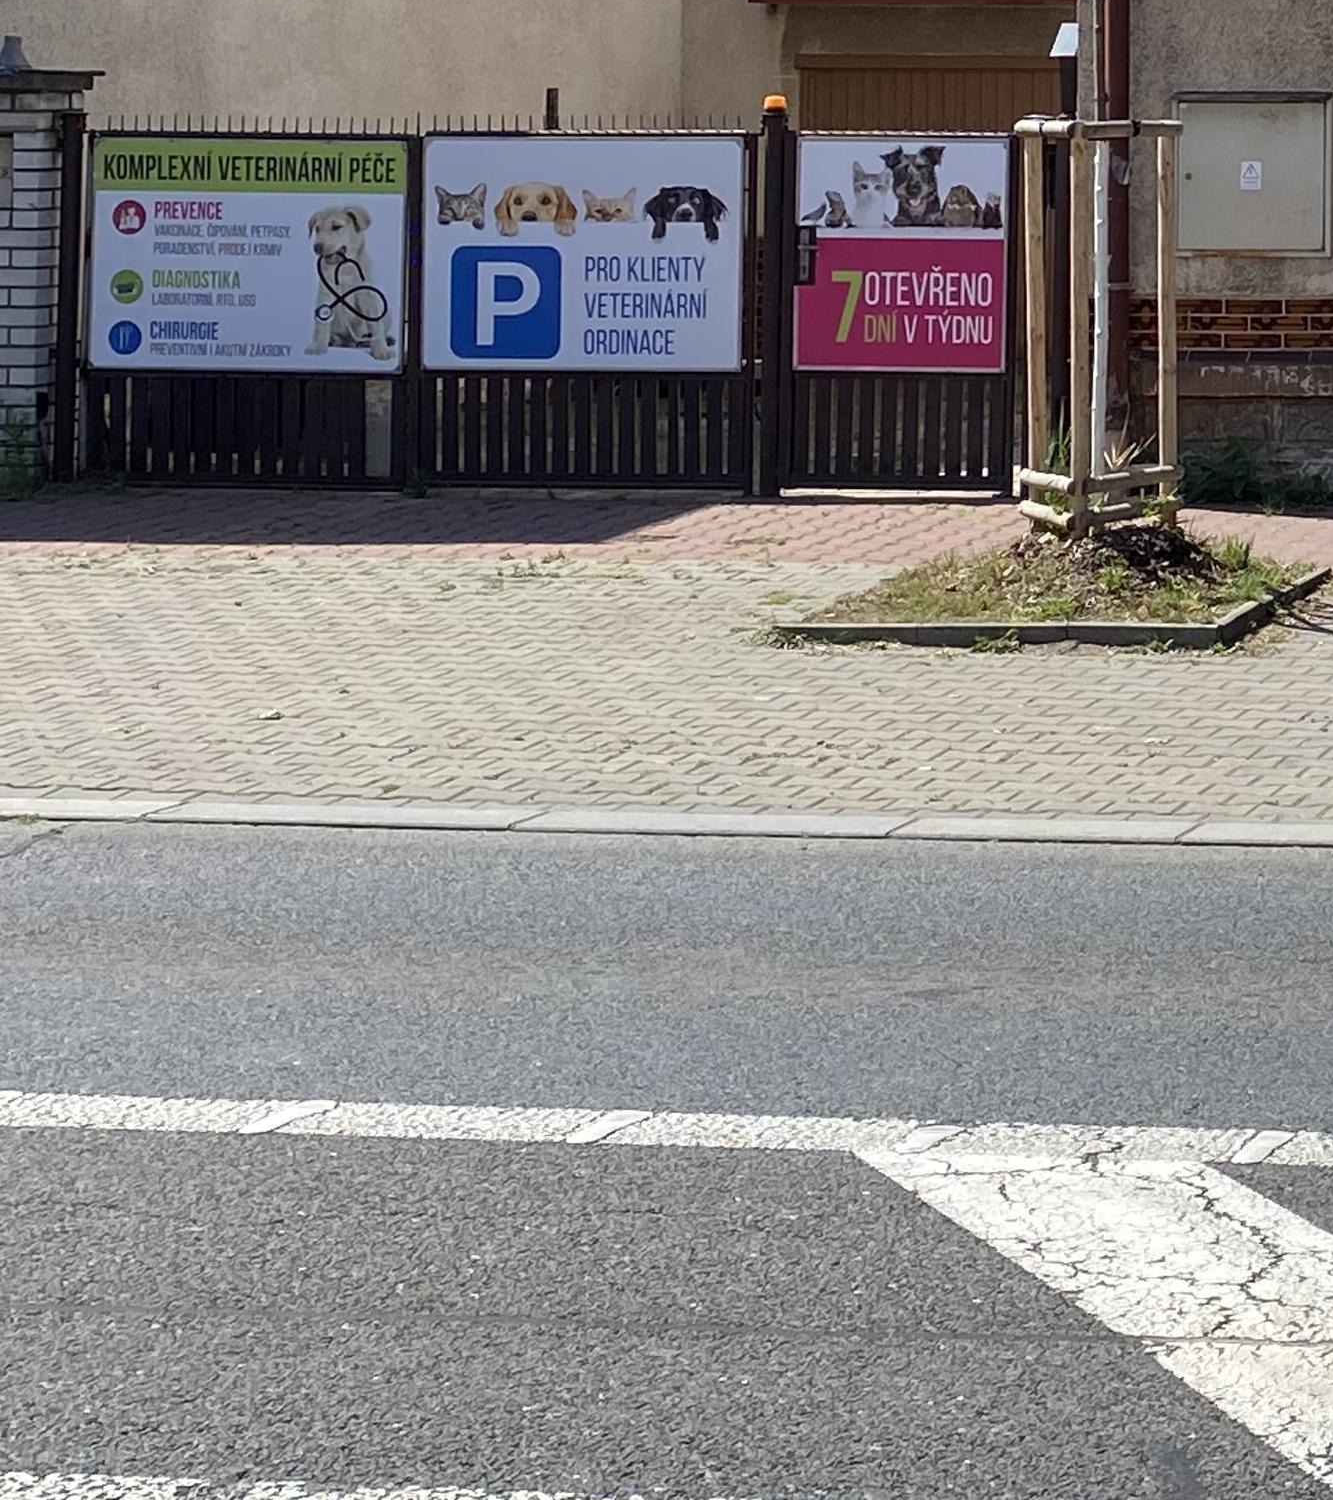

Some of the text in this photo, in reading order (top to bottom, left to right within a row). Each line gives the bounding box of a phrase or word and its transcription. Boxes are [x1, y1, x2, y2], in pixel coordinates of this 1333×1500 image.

[103, 150, 396, 184] KOMPLEXNÍ VETERINÁRNÍ PÉČE
[154, 200, 224, 220] PREVENCE
[151, 269, 241, 290] DIAGNOSTIKA
[584, 255, 706, 283] PRO KLIENTY
[476, 261, 541, 346] P
[583, 288, 708, 319] VETERINÁRNÍ
[831, 265, 993, 343] 7 OTEVŘENO
[150, 320, 220, 341] CHIRURGIE
[864, 309, 993, 344] DNÍ V TÝDNU
[583, 328, 676, 356] ORDINACE
